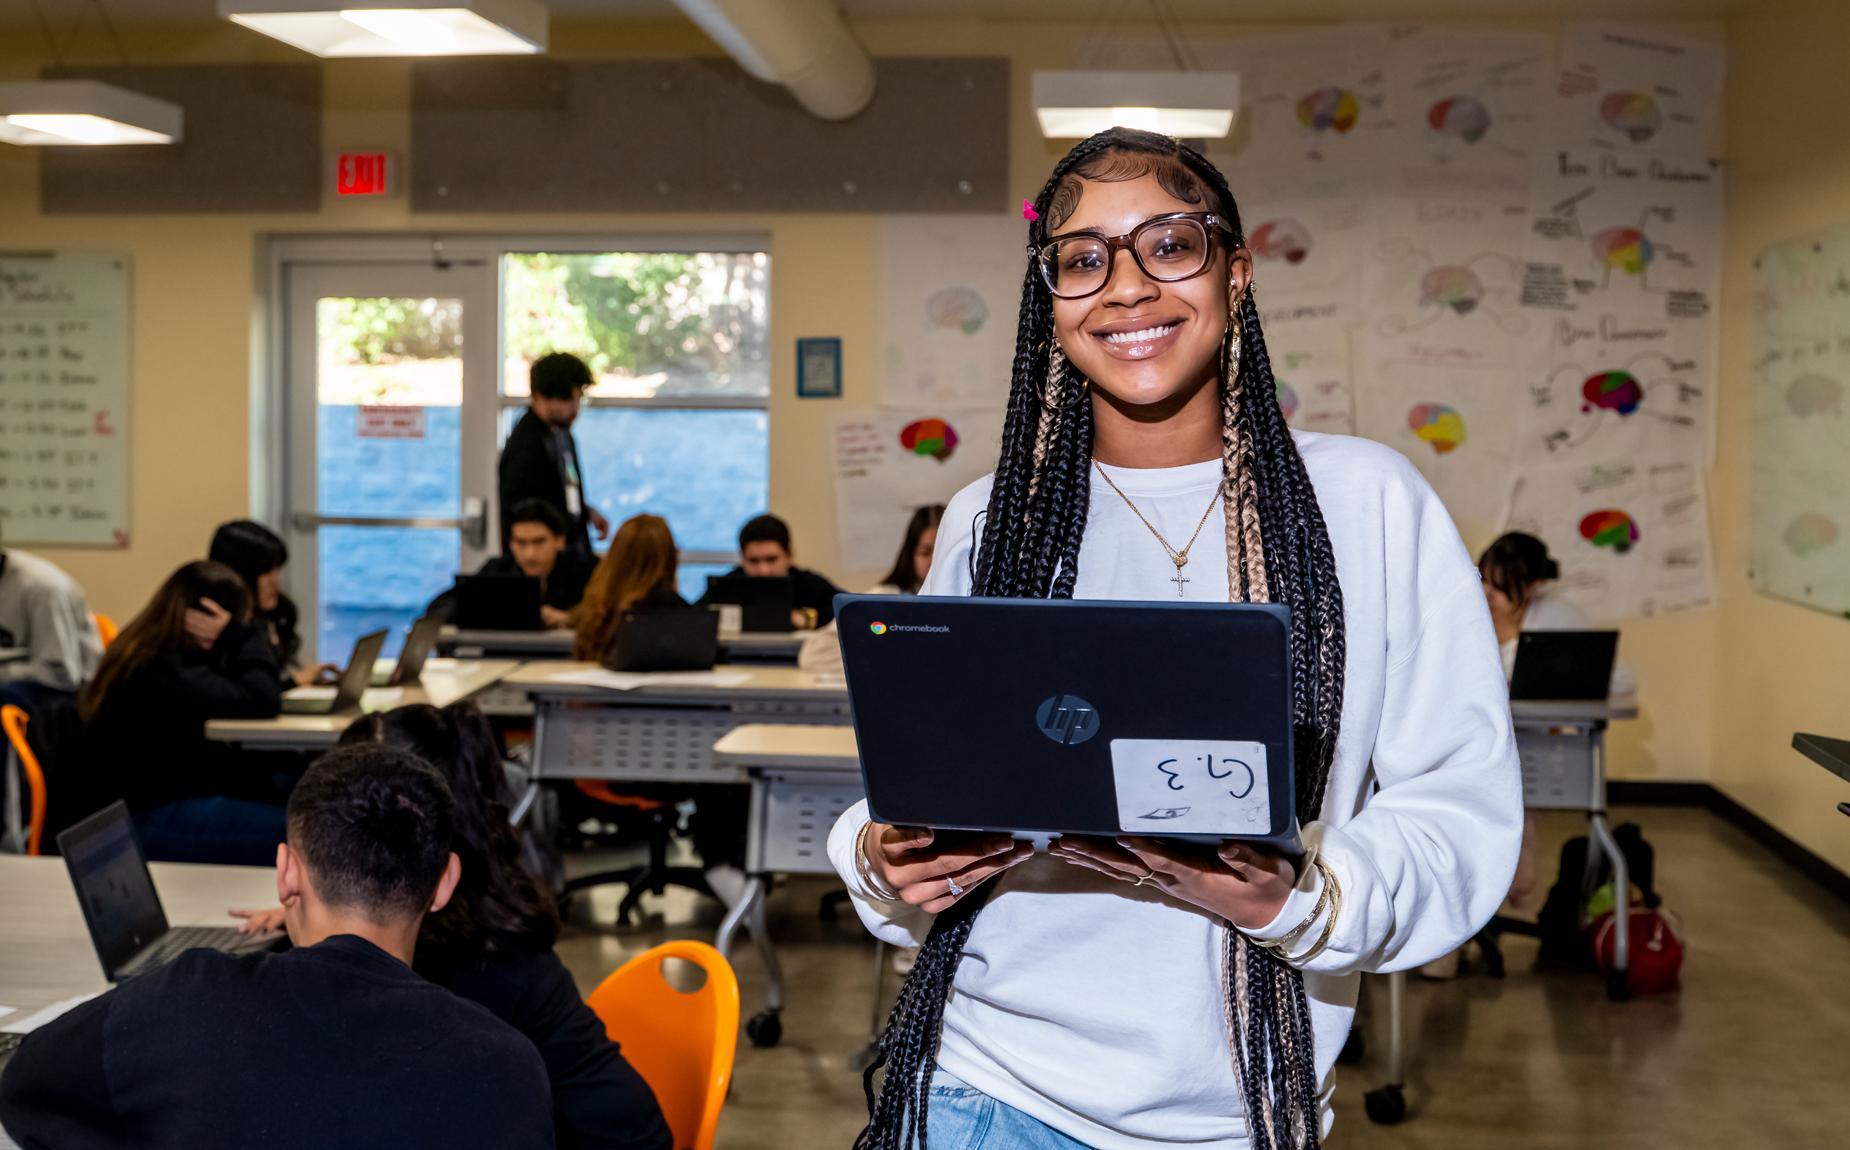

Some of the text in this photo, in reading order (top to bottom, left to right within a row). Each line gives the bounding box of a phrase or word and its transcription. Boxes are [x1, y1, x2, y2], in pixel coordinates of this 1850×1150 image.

[337, 153, 386, 194] EXIT
[888, 623, 950, 634] chromebook
[1041, 694, 1096, 744] hp
[1156, 758, 1186, 791] 3
